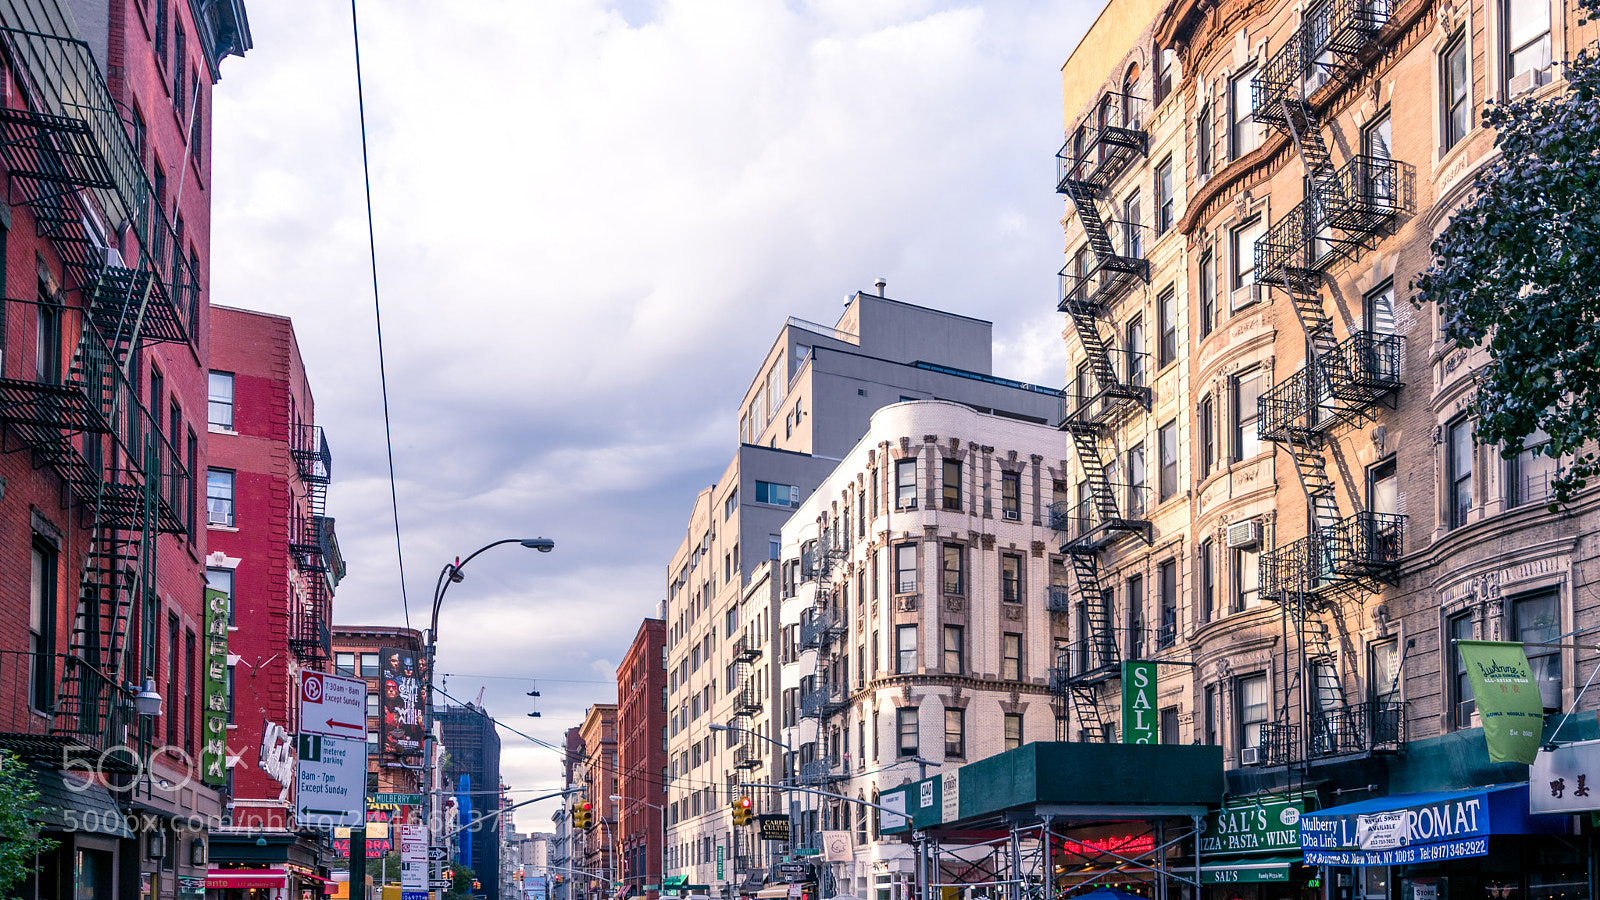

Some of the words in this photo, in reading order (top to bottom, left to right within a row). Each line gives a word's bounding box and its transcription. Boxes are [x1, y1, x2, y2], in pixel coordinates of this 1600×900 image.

[349, 686, 360, 695] 8am
[325, 693, 342, 703] Except
[343, 697, 360, 708] Sunday
[208, 692, 226, 778] ROMA
[307, 735, 314, 758] 1
[323, 748, 346, 756] metered
[322, 756, 343, 766] parking
[302, 770, 316, 780] 8am
[322, 773, 335, 783] 7pm
[302, 782, 323, 795] Except
[325, 784, 348, 796] Sunday
[376, 794, 410, 803] MULBERRY
[1218, 809, 1267, 834] SAL'S
[1302, 817, 1338, 834] Mulberry
[1200, 837, 1221, 850] IZZA
[1228, 834, 1258, 849] PASTA
[1266, 830, 1296, 846] WINE
[1302, 834, 1318, 847] Dba
[1320, 834, 1337, 848] Lin's
[1352, 853, 1364, 864] New
[1384, 851, 1392, 863] NY
[1396, 850, 1414, 862] 10013
[1450, 840, 1486, 856] 346-2922
[1215, 870, 1238, 881] SAL'S
